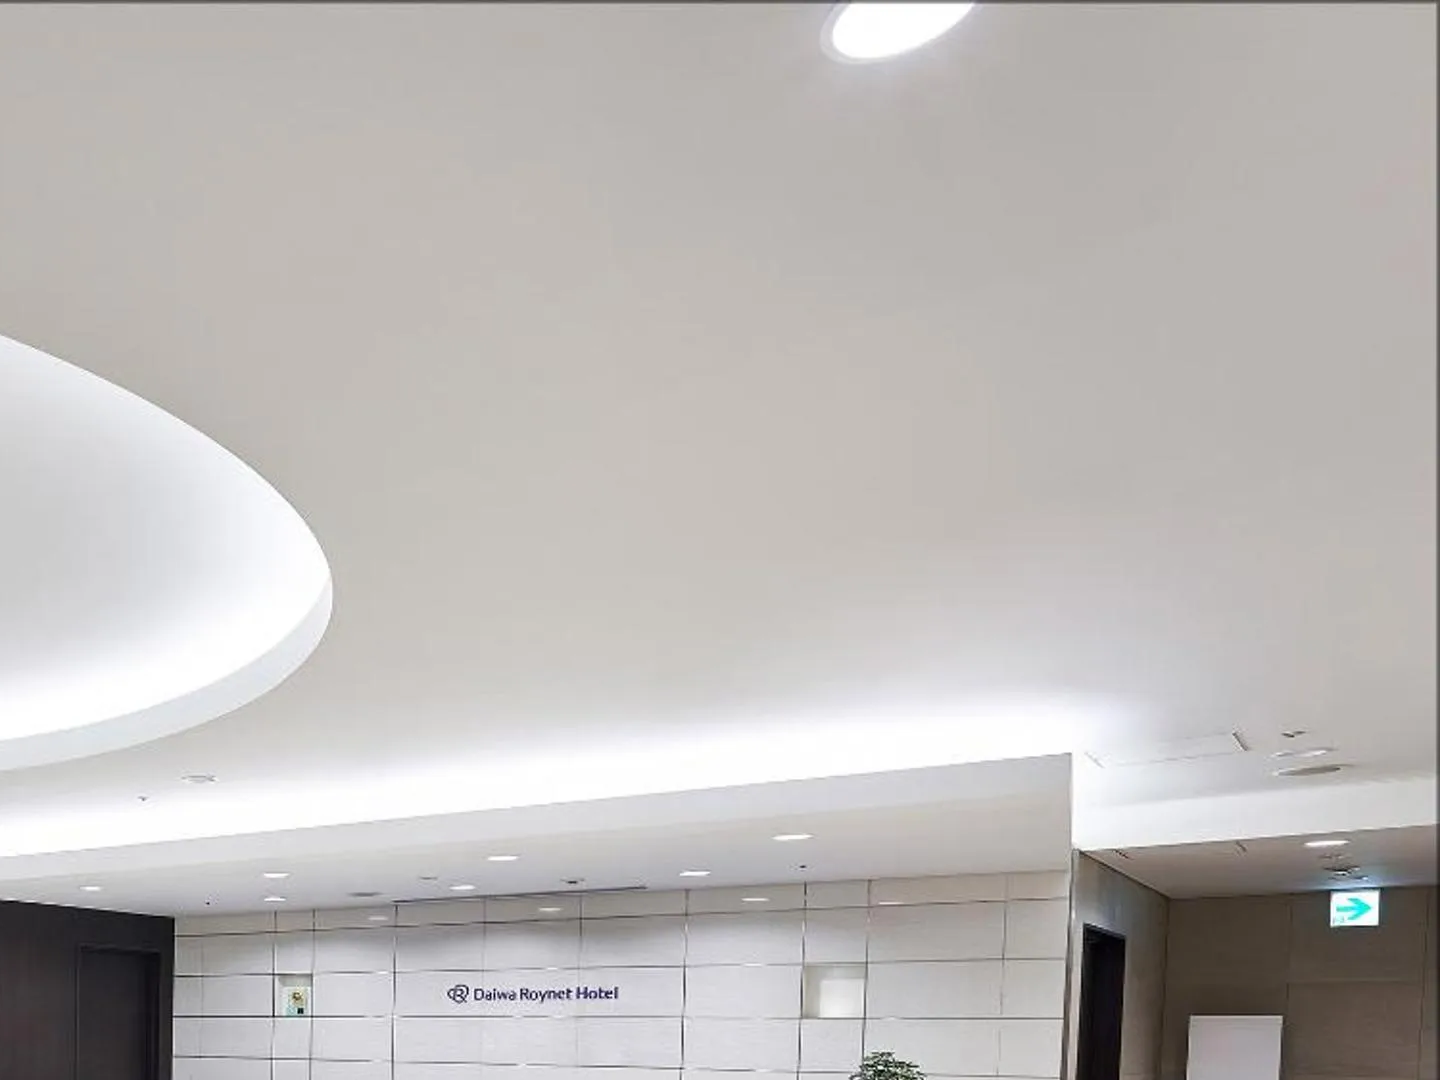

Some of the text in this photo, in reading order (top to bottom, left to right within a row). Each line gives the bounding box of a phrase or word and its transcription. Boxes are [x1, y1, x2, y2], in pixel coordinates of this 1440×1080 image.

[473, 987, 517, 1001] Daiwa
[519, 988, 572, 1003] Roynet
[576, 986, 619, 1000] Hotel
